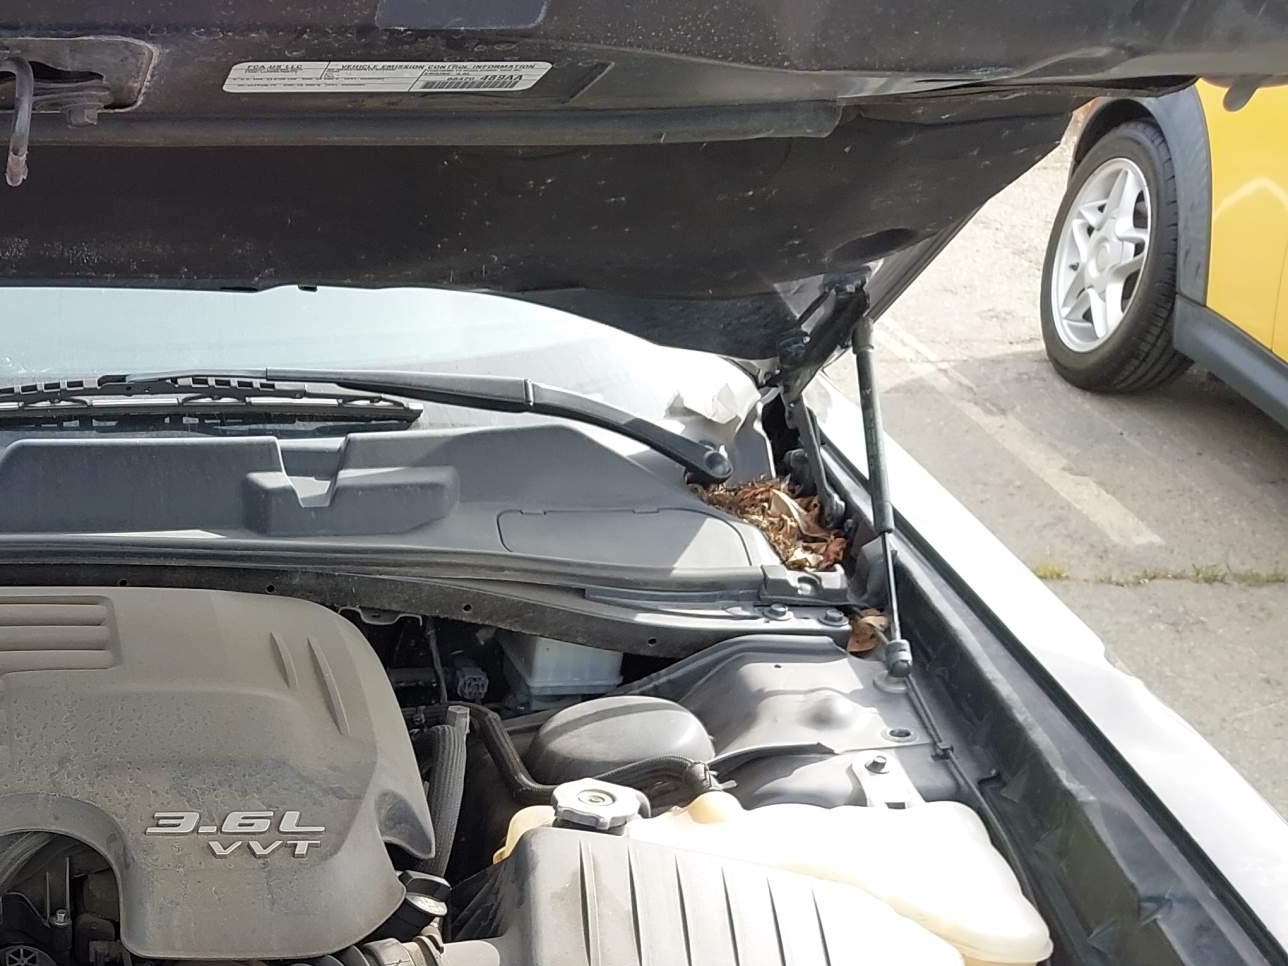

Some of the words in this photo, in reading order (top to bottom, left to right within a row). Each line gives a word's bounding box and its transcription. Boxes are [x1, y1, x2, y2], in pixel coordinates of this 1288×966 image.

[480, 74, 524, 82] 489AA
[145, 810, 326, 836] 3.6L
[208, 840, 322, 859] VVT
